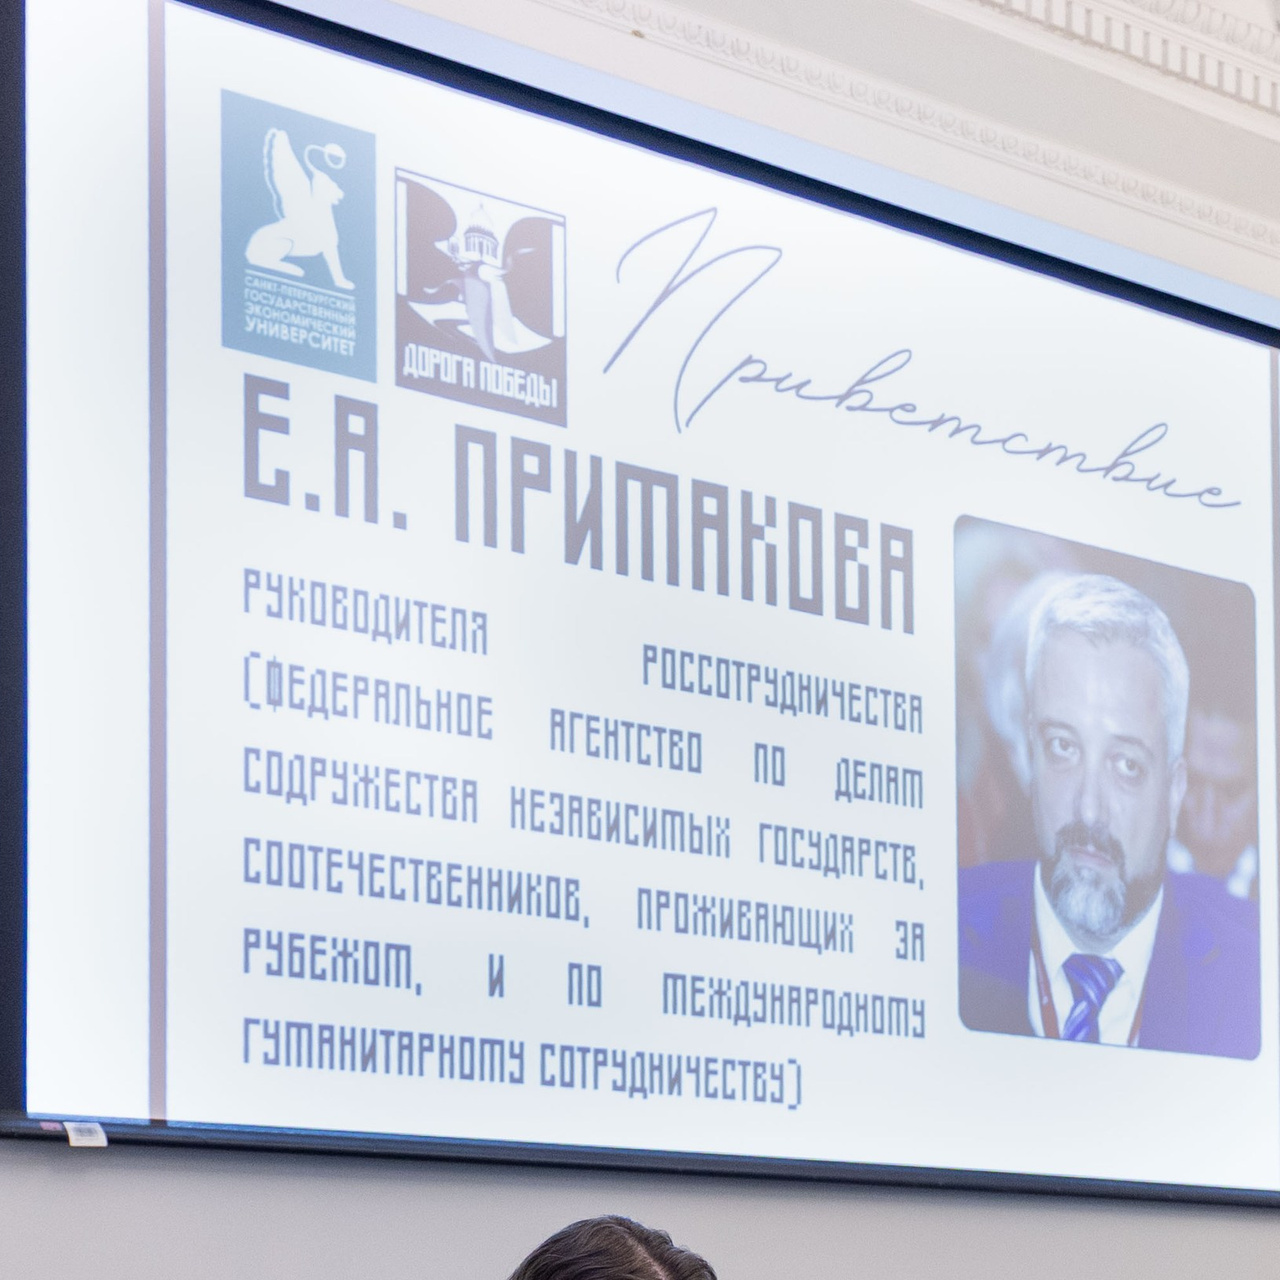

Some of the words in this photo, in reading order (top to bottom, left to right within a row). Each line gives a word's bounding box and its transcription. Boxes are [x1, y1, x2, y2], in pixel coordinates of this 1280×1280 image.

[244, 287, 356, 325] ГОСУДАРСТВЕННЫЙ
[244, 301, 356, 339] ЭКОНОМИЧЕСКИЙ
[244, 315, 356, 357] УНИВЕРСИТЕТ
[603, 206, 1242, 508] Приветствие
[403, 343, 475, 389] ДОРОГА
[479, 361, 558, 408] ПОБЕДЫ
[454, 423, 914, 635] ПРИМАКОВА
[243, 567, 488, 655] РУКОВОДИТЕЛЯ
[643, 643, 923, 734] РОССОТРУДНИЧЕСТВА
[243, 651, 493, 740] (ФЕДЕРАЛЬНОЕ
[550, 708, 702, 774] АГЕНТСТВО
[754, 742, 785, 787] ПО
[835, 757, 923, 809] ДЕЛАМ
[243, 747, 478, 824] СОДРУЖЕСТВА
[510, 786, 730, 859] НЕЗАВИСИМЫХ
[759, 823, 924, 890] ГОСУДАРСТВ,
[243, 837, 589, 928] СООТЕЧЕСТВЕННИКОВ,
[637, 887, 853, 955] ПРОЖИВАЮЩИХ
[895, 920, 925, 962] ЗА
[243, 928, 422, 996] РУБЕЖОМ,
[488, 953, 504, 998] И
[568, 962, 601, 1008] ПО
[663, 972, 925, 1038] МЕЖДУНАРОДНОМУ
[243, 1017, 524, 1084] ГУМАНИТАРНОМУ
[540, 1042, 801, 1110] СОТРУДНИЧЕСТВУ)
